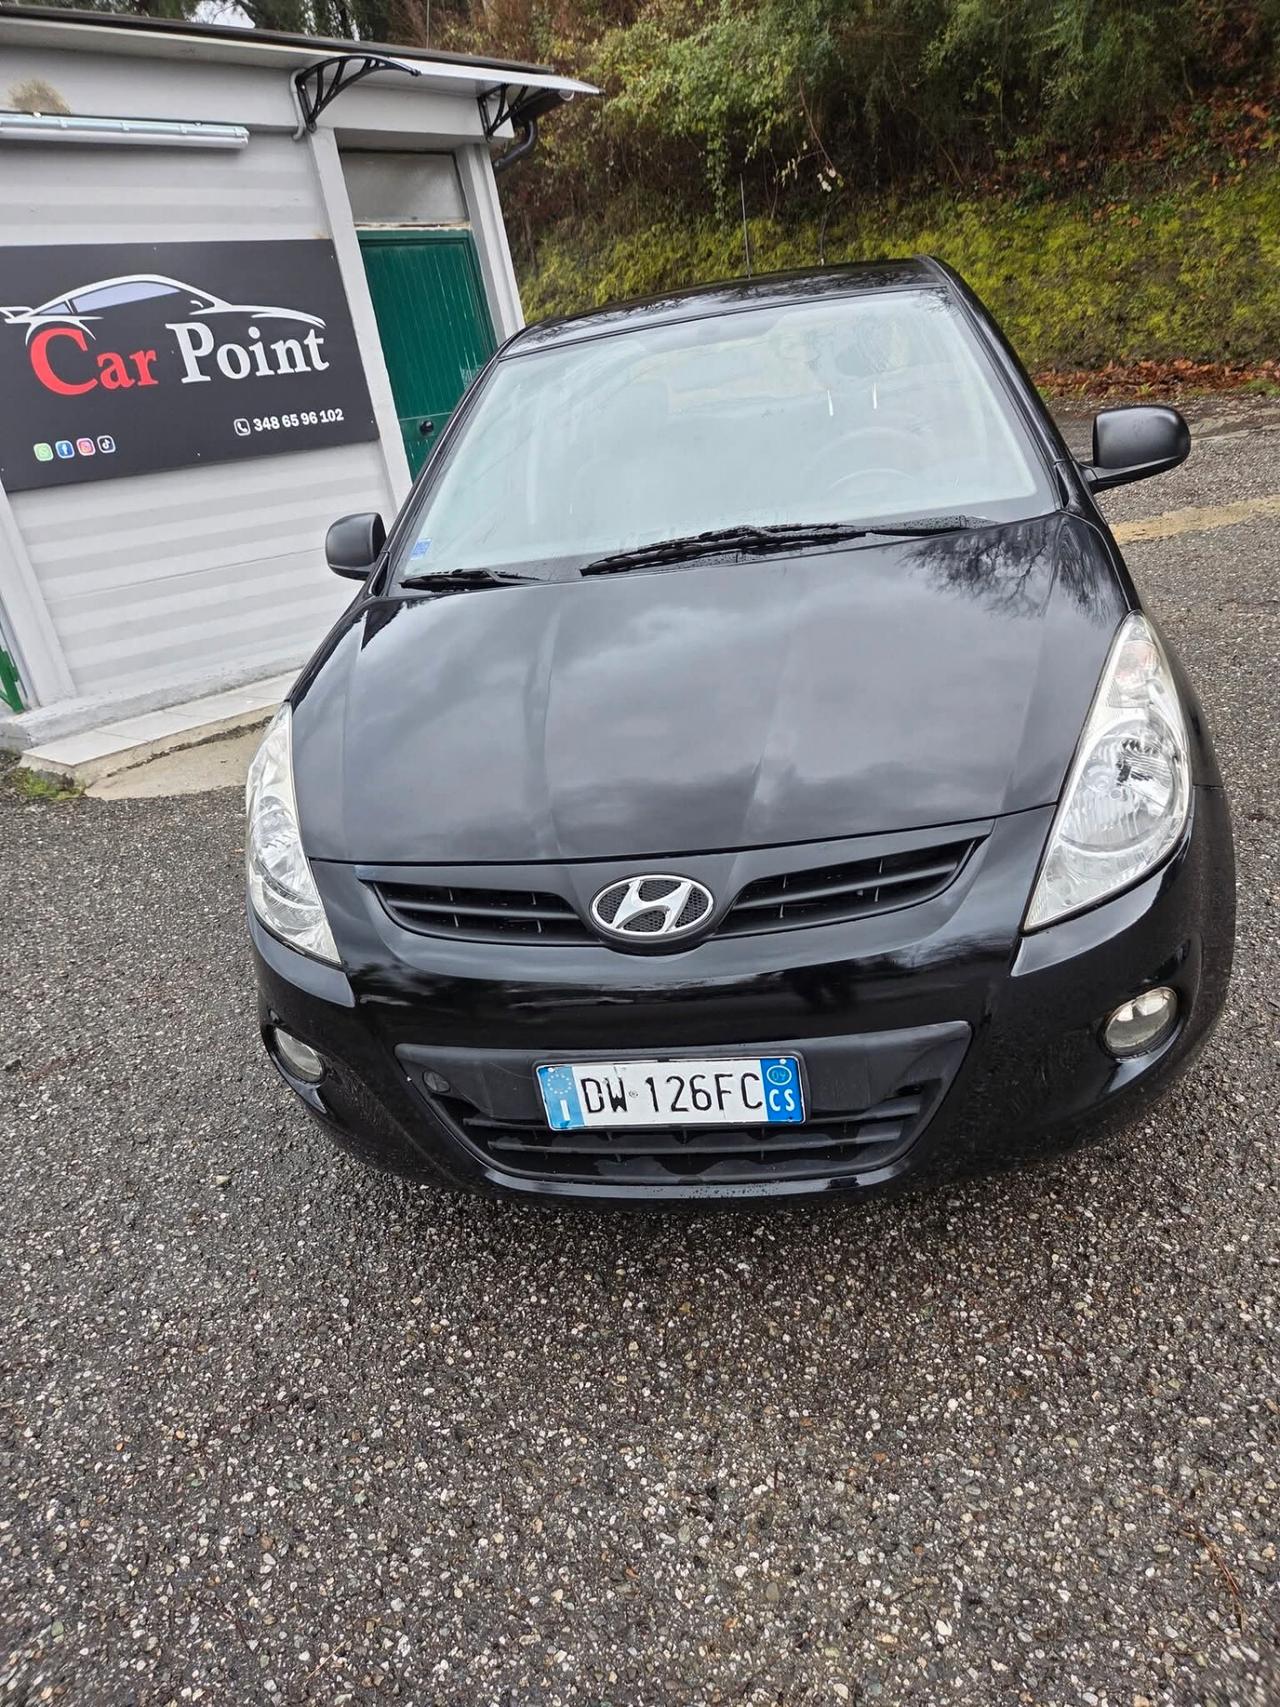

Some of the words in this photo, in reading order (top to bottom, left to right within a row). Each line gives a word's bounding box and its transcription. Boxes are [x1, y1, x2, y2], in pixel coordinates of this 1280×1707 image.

[30, 327, 159, 396] Car
[165, 322, 330, 384] Point
[253, 414, 280, 432] 348
[282, 413, 300, 428] 65
[301, 411, 318, 426] 96
[320, 408, 344, 423] 102
[559, 1099, 571, 1121] I
[581, 1077, 628, 1113] DW
[645, 1073, 763, 1113] 126FC
[769, 1088, 795, 1112] CS
